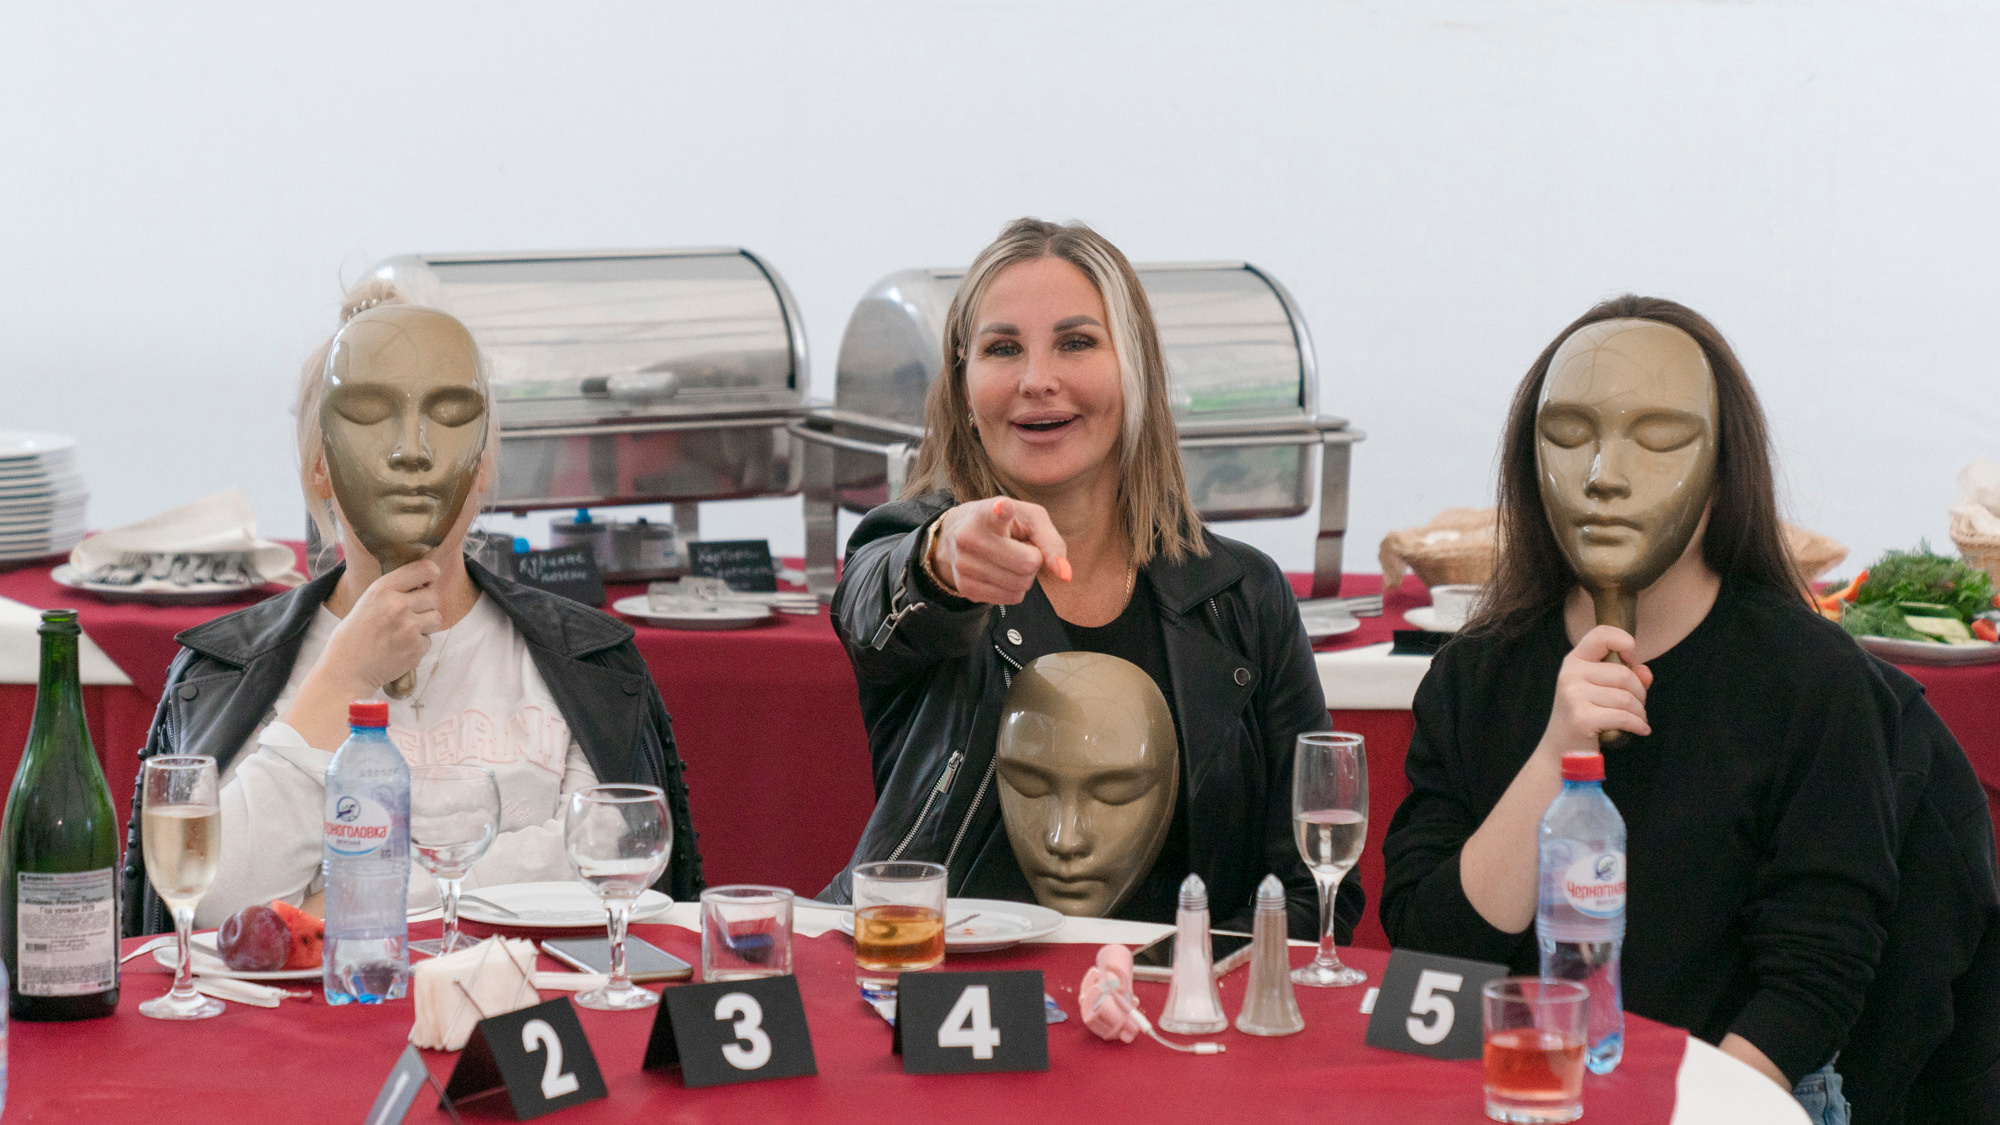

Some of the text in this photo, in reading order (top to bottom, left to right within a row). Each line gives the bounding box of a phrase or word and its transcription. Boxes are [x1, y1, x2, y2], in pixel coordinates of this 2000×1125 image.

[714, 992, 772, 1070] 3
[938, 985, 1001, 1060] 4
[1406, 968, 1464, 1046] 5
[521, 1018, 580, 1100] 2
